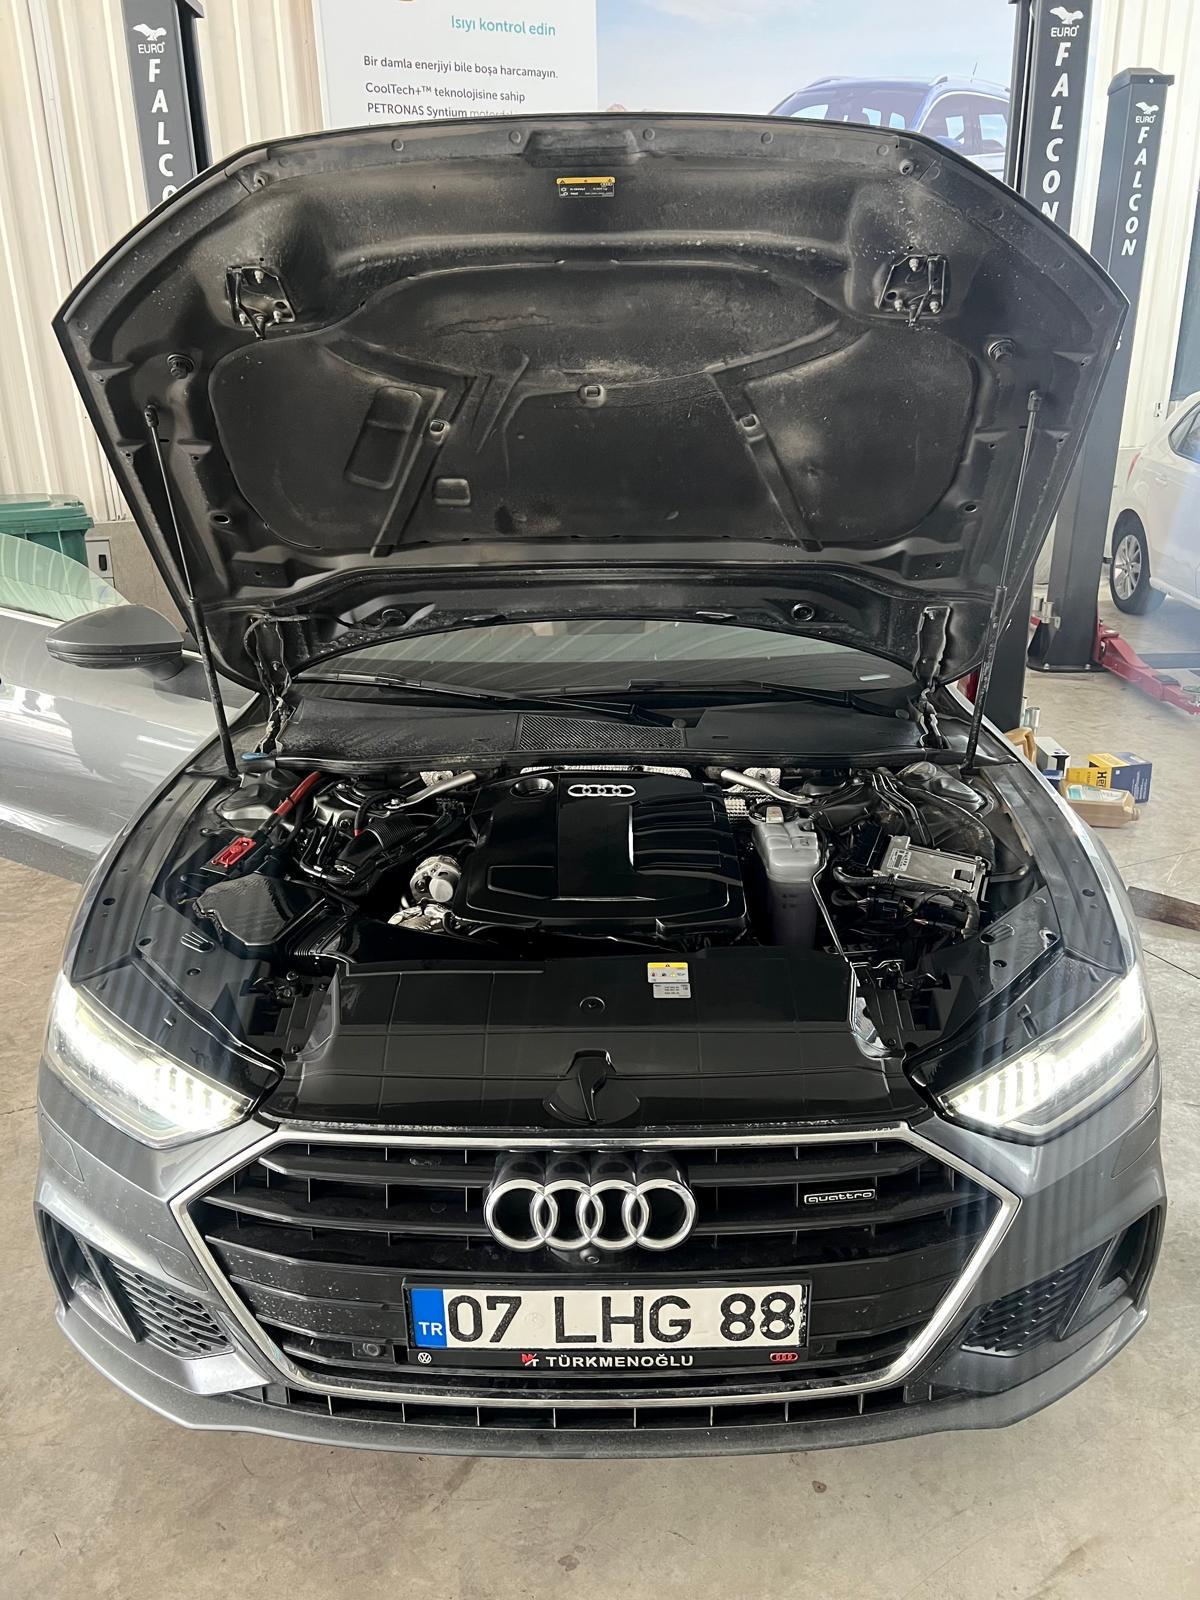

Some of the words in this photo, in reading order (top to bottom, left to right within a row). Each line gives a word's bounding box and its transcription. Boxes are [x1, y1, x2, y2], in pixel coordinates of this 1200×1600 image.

[451, 15, 476, 33] Isıyı
[479, 17, 526, 34] kontrol
[529, 22, 556, 36] edin
[1051, 25, 1078, 37] EURO
[138, 42, 165, 54] EURO
[363, 55, 378, 67] Bir
[380, 57, 413, 69] damla
[415, 60, 452, 74] enerjiyi
[454, 61, 473, 73] bile
[475, 63, 498, 77] boşa
[500, 65, 559, 80] harcamayın.
[434, 86, 498, 101] teknolojisine
[500, 91, 526, 104] sahip
[367, 102, 424, 116] PETRONAS
[426, 105, 467, 119] Syntium
[1135, 115, 1156, 124] EURO
[1121, 126, 1150, 256] FALCON
[808, 1191, 872, 1203] quattro
[418, 1321, 443, 1336] TR
[447, 1294, 522, 1343] 07
[553, 1295, 692, 1344] LHG
[719, 1291, 796, 1342] 88
[546, 1352, 694, 1368] TÜRKMENOĞLU
